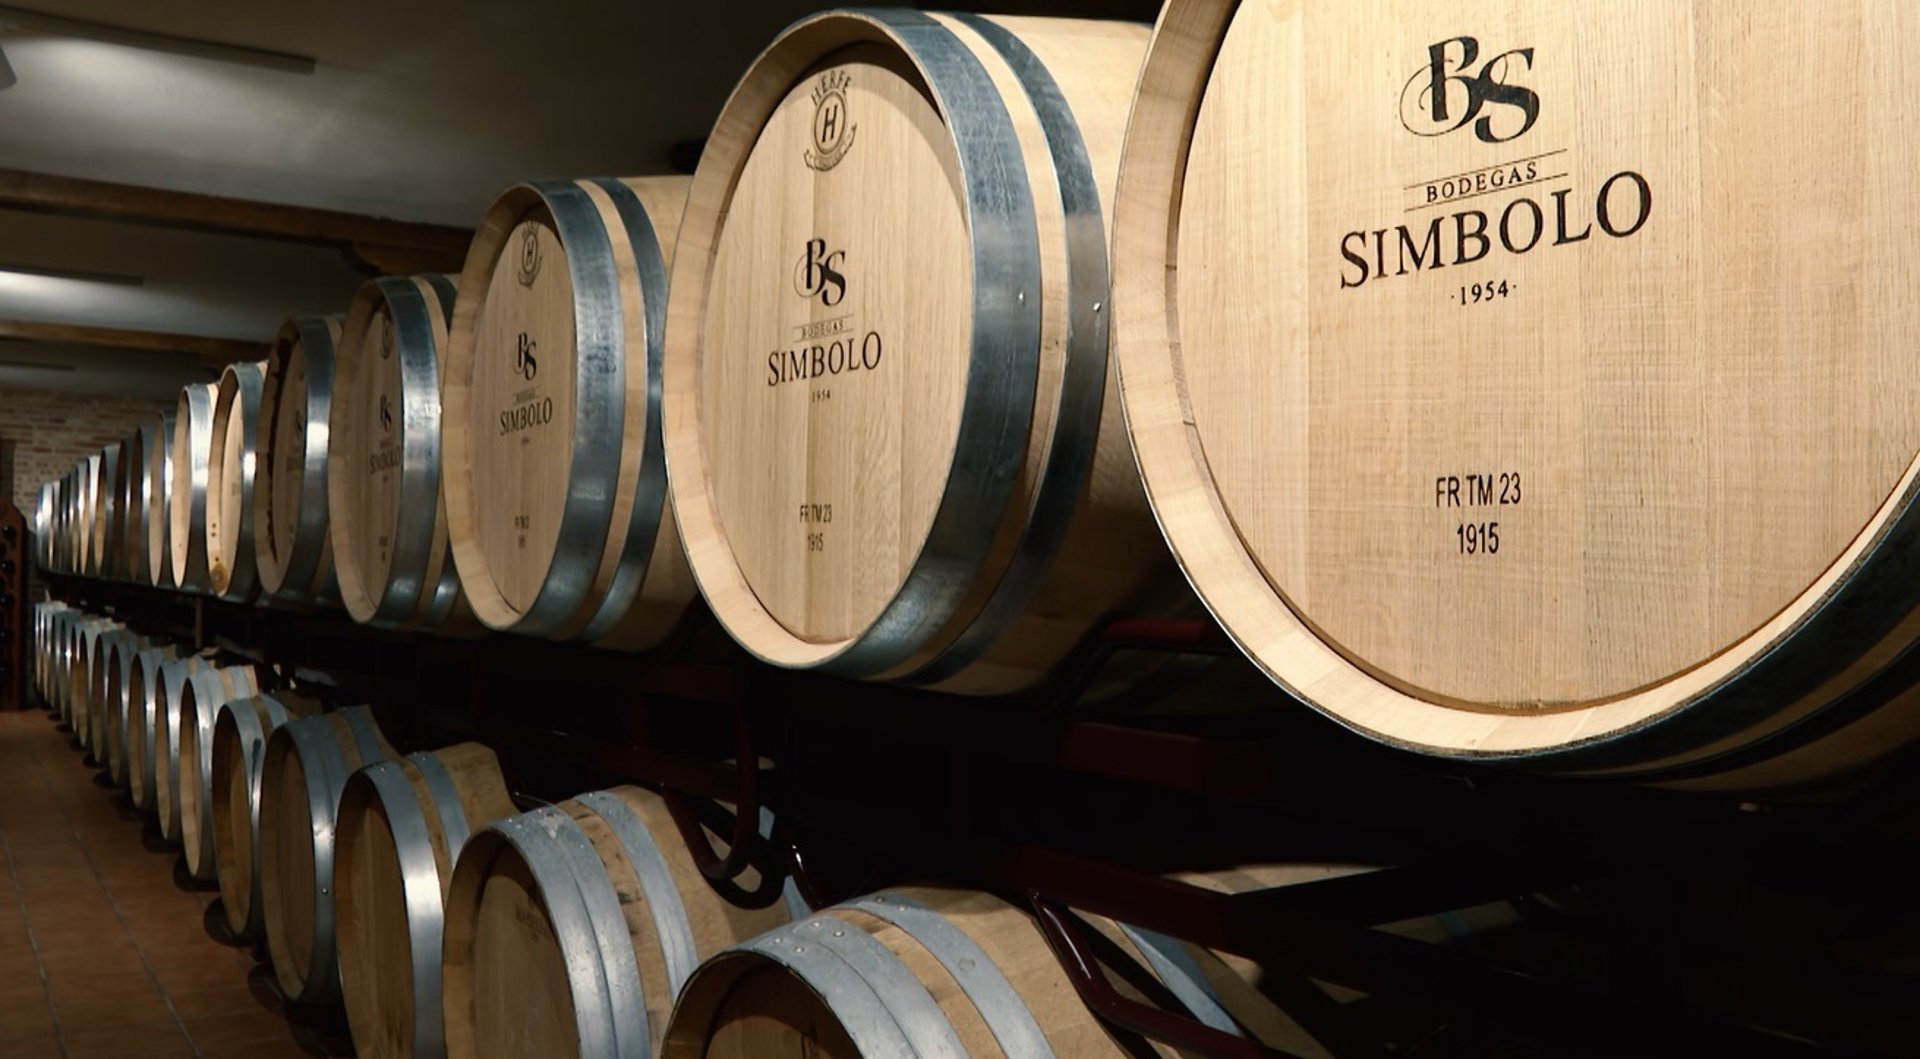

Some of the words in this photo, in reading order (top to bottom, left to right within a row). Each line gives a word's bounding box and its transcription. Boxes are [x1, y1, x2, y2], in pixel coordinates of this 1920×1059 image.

[1426, 161, 1538, 203] BODEGAS
[1340, 170, 1652, 289] SIMBOLO
[801, 319, 844, 339] BODEGAS
[767, 330, 883, 387] SIMBOLO
[499, 396, 553, 436] SIMBOLO
[1435, 476, 1461, 508] FR
[1466, 473, 1493, 506] TM
[1499, 472, 1522, 505] 23
[1456, 522, 1499, 555] 1915
